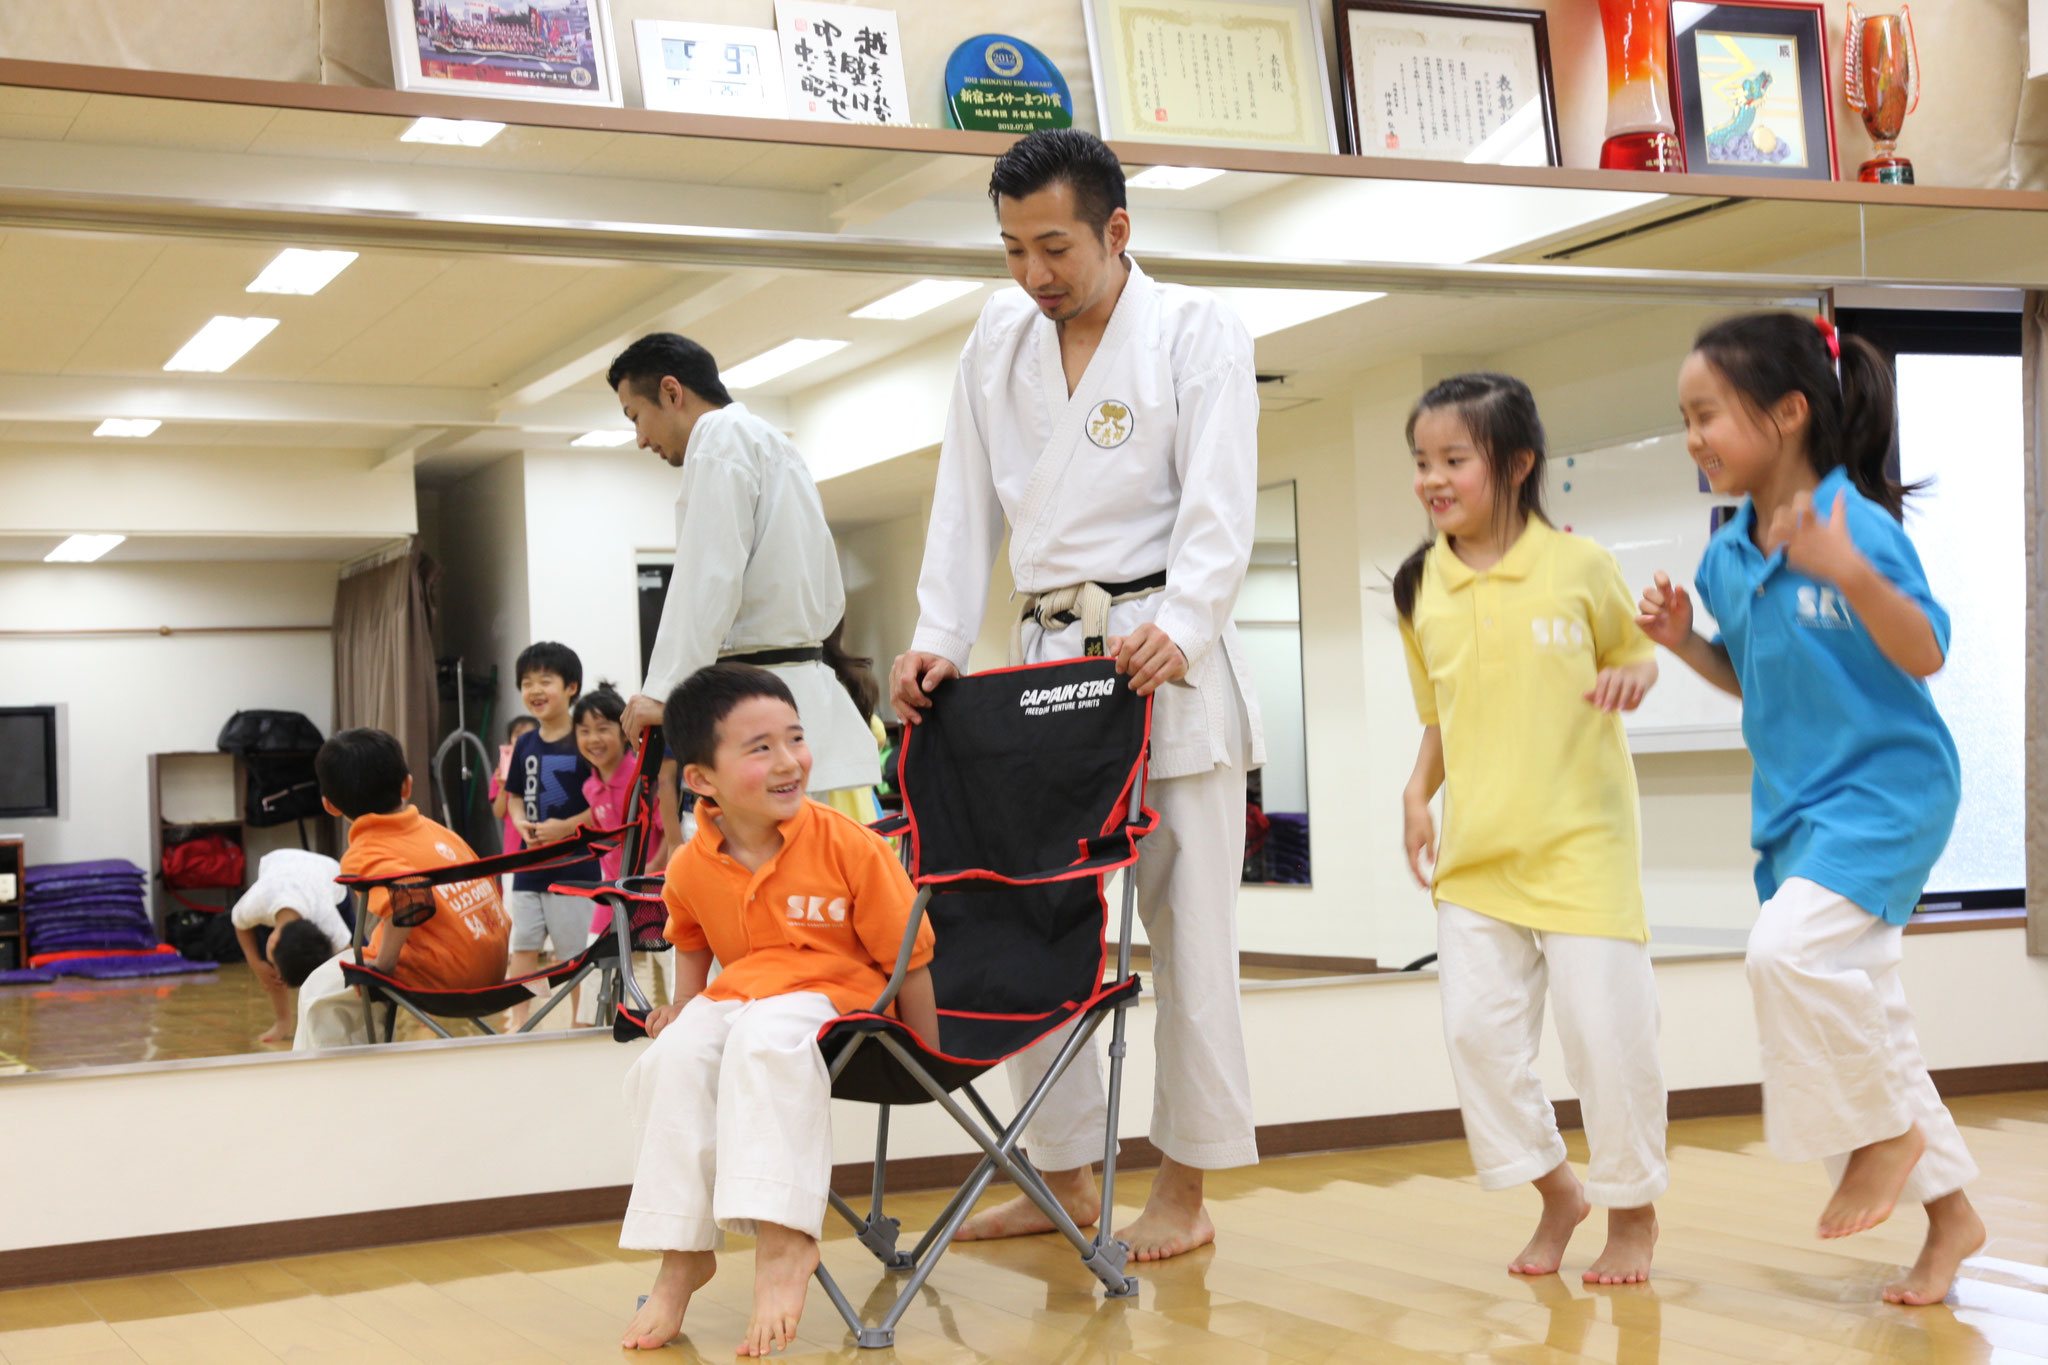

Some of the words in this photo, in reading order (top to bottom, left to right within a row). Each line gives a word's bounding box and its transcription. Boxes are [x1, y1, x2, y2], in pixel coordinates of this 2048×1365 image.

[980, 78, 1012, 86] SHINJUKU
[1020, 684, 1078, 707] CAPTAIN
[1076, 678, 1115, 698] STAG
[1025, 705, 1050, 715] FREEDOM
[1052, 701, 1075, 713] VENTURE
[1078, 698, 1100, 709] SPIRITS
